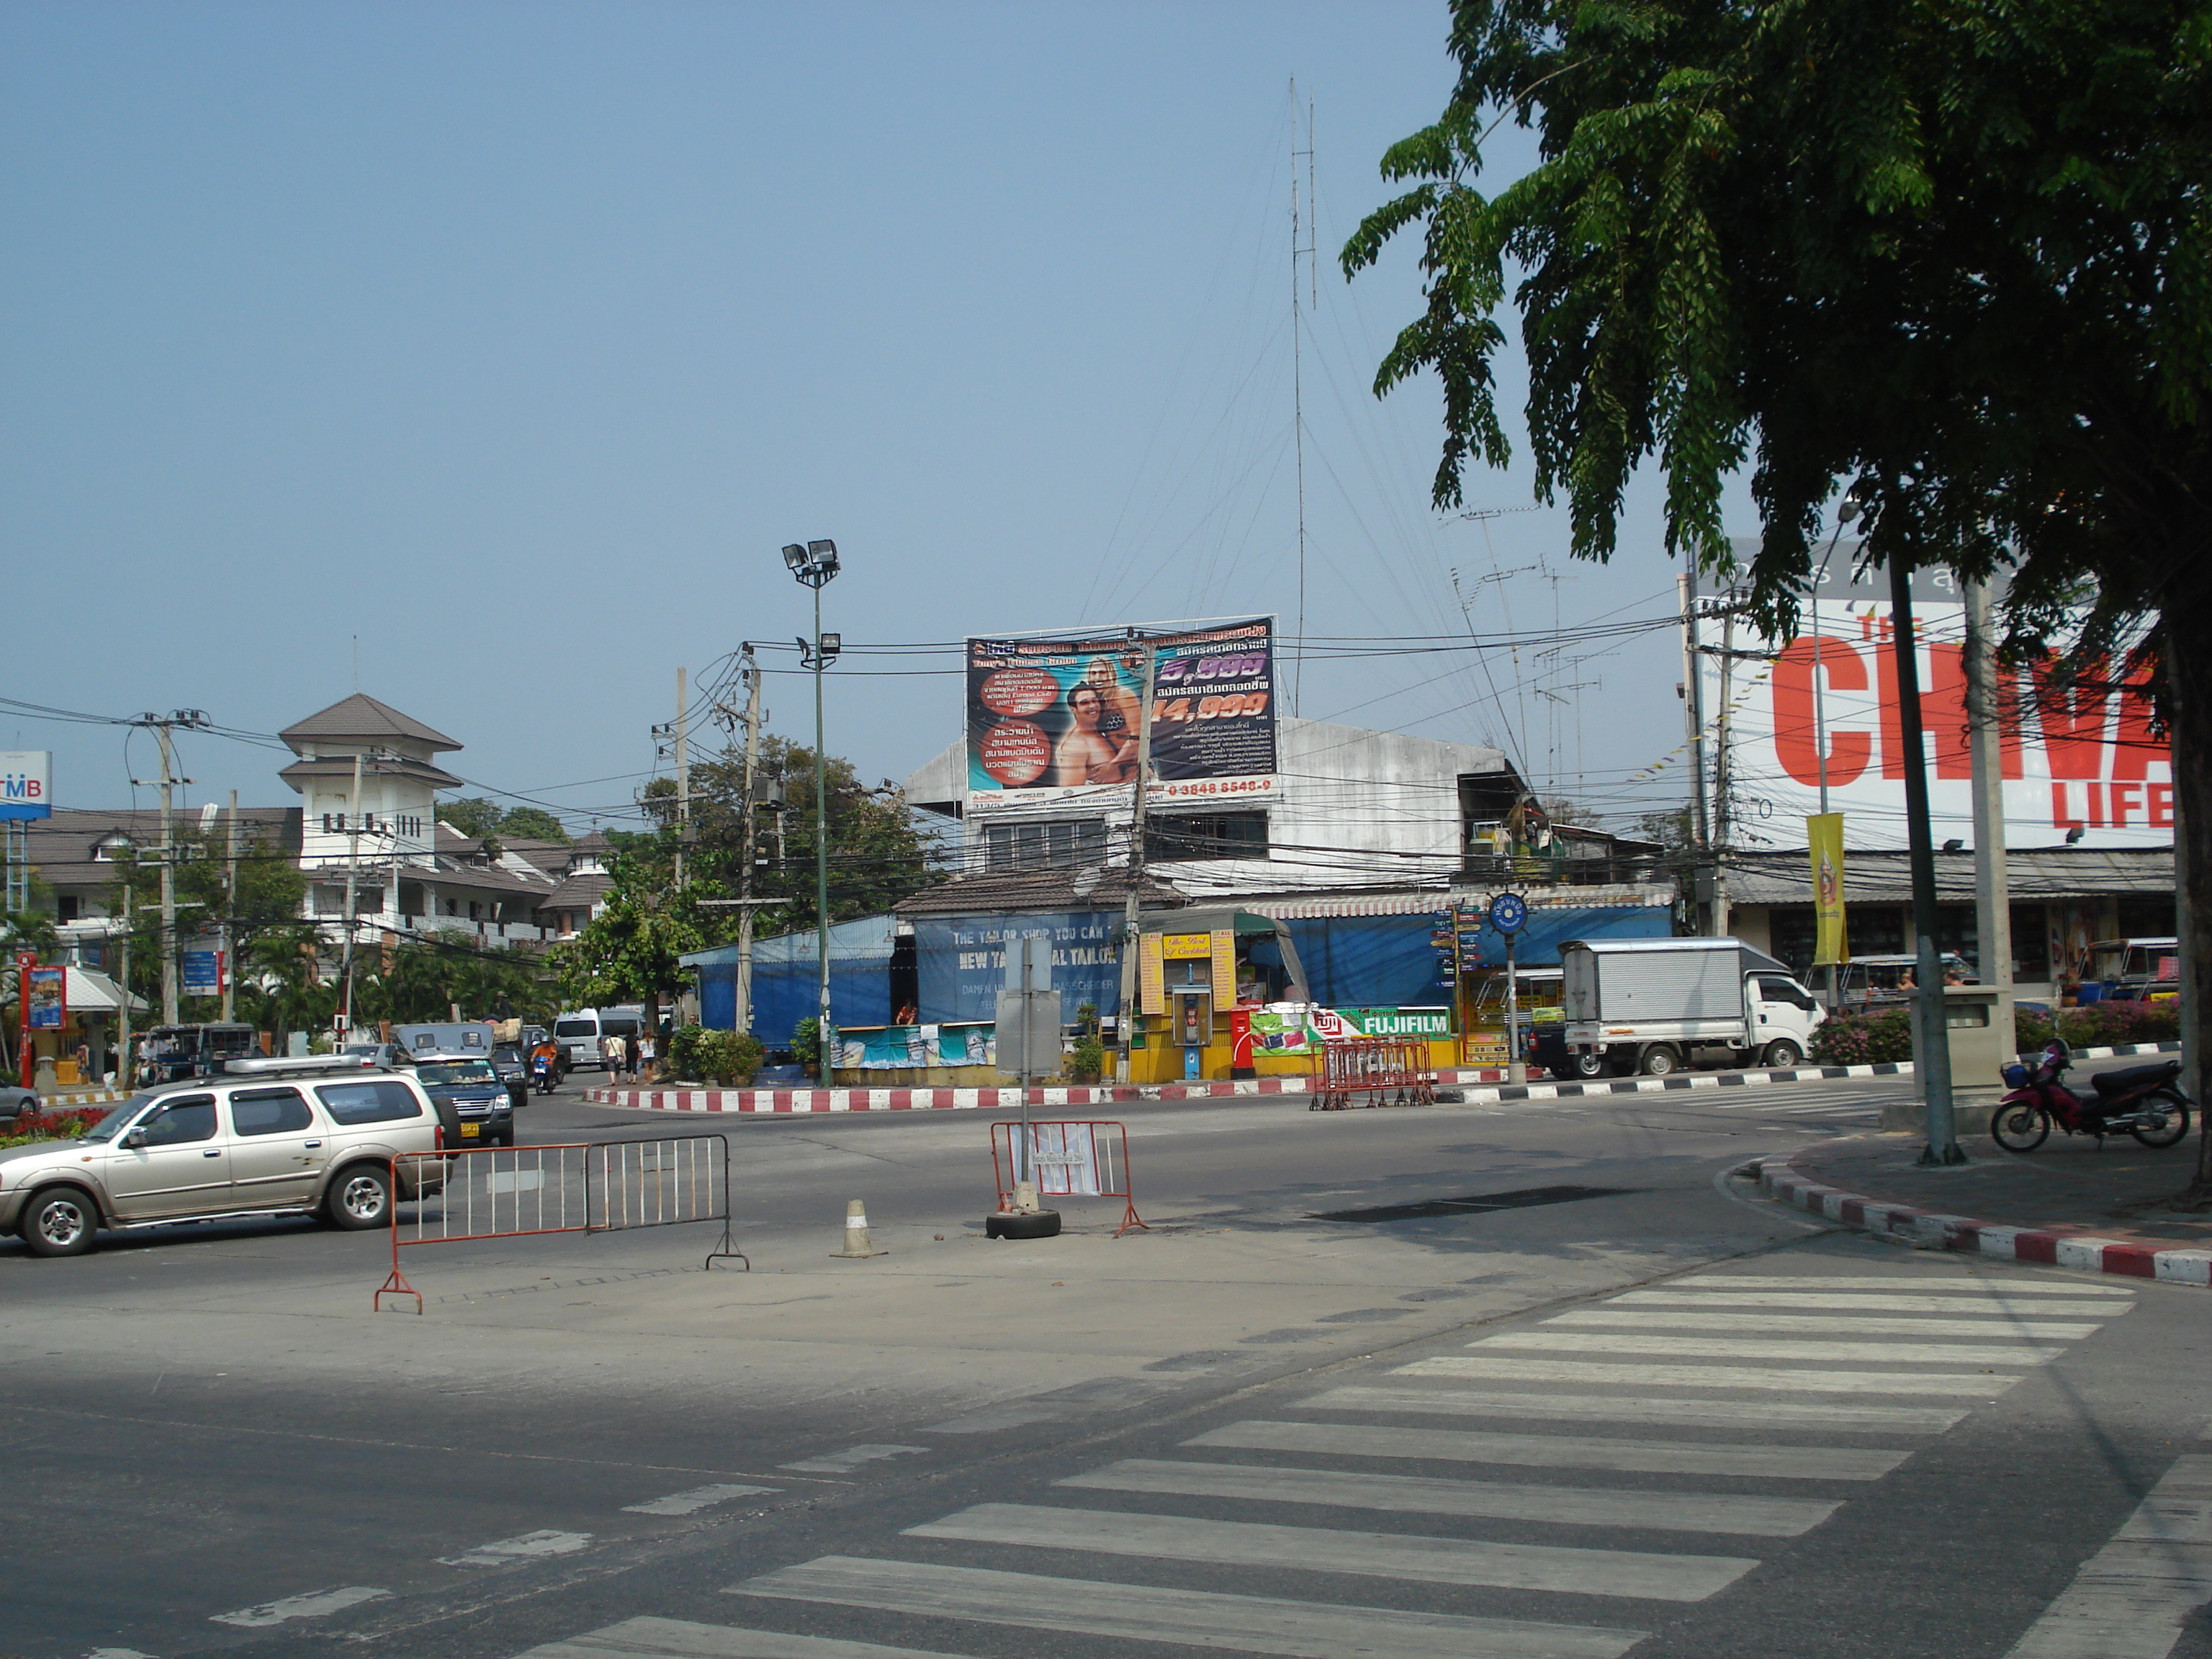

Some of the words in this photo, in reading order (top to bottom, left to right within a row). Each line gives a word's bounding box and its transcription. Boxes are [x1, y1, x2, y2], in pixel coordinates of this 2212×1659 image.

[1181, 783, 1217, 795] 3848
[1220, 780, 1271, 793] 8548-9
[1022, 928, 1050, 940] SHOP
[1055, 927, 1076, 940] YOU
[959, 951, 987, 970] NEW
[1364, 1016, 1447, 1033] FUJIFILM
